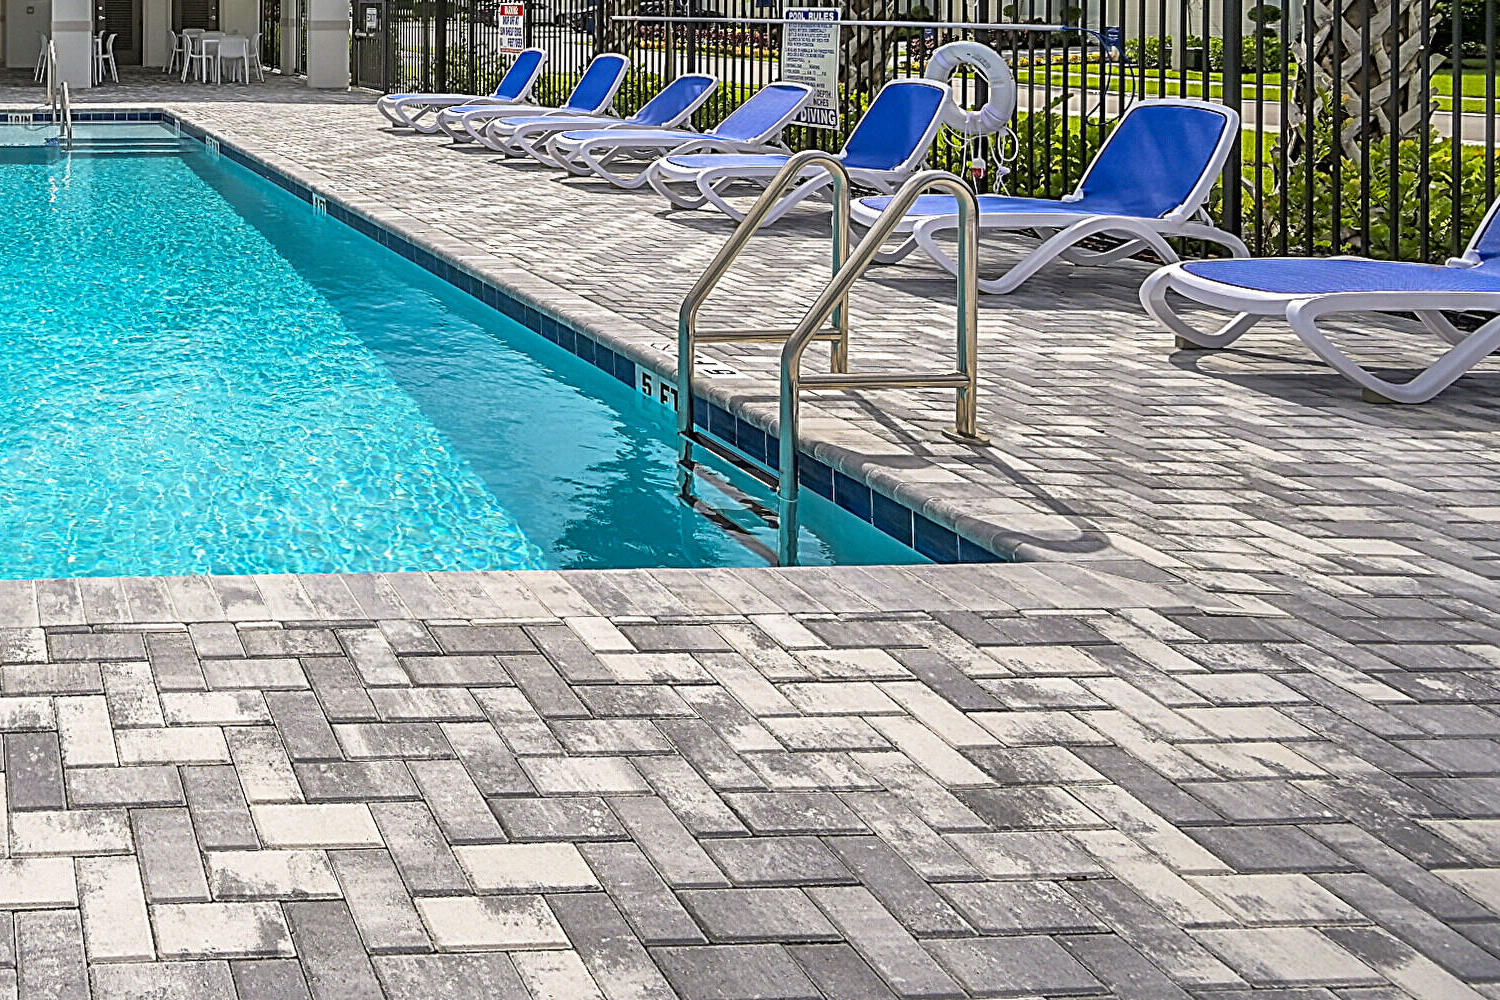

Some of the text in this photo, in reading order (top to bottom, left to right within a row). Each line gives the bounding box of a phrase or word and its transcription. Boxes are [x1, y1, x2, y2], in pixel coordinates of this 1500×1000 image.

[789, 11, 835, 21] POOL RULES
[800, 108, 837, 125] DIVING
[642, 371, 652, 397] 5
